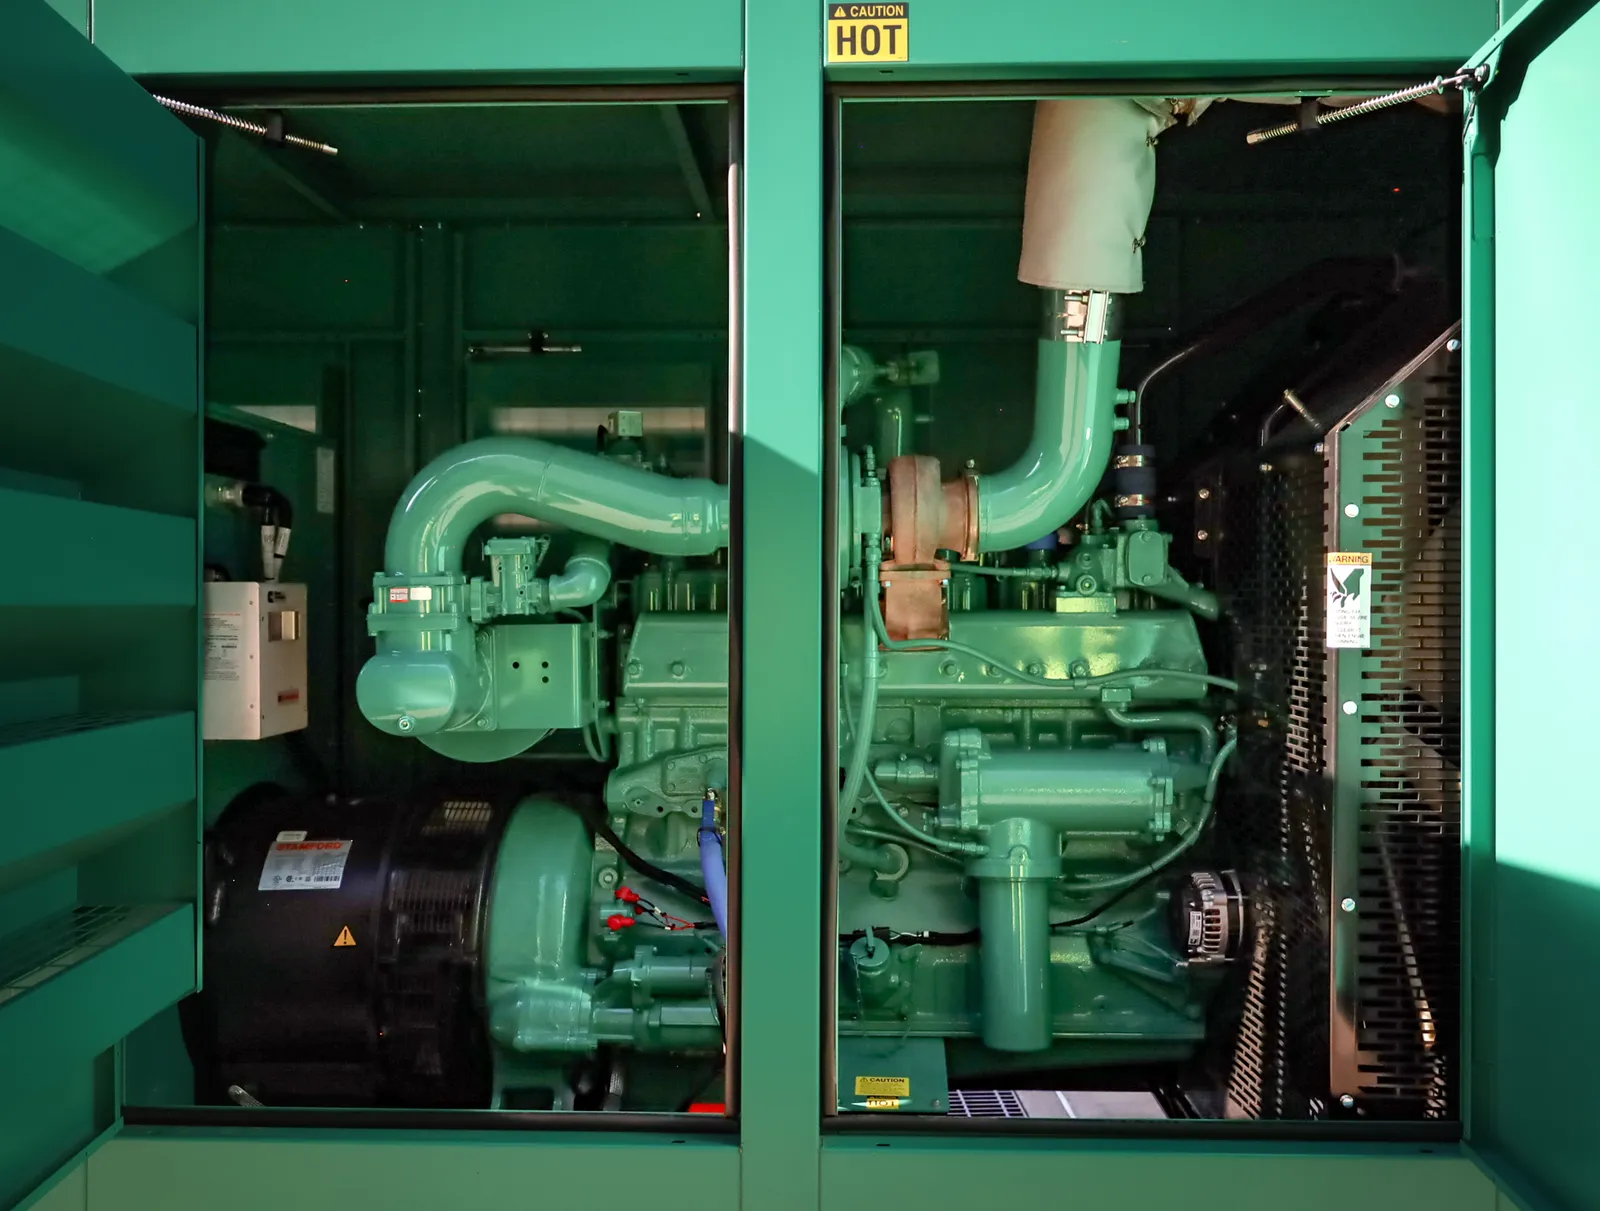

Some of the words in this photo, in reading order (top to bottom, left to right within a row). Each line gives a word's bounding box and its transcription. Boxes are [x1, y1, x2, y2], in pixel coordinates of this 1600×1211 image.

[850, 5, 904, 17] CAUTION
[837, 24, 902, 56] HOT
[275, 842, 344, 851] STAMFORD
